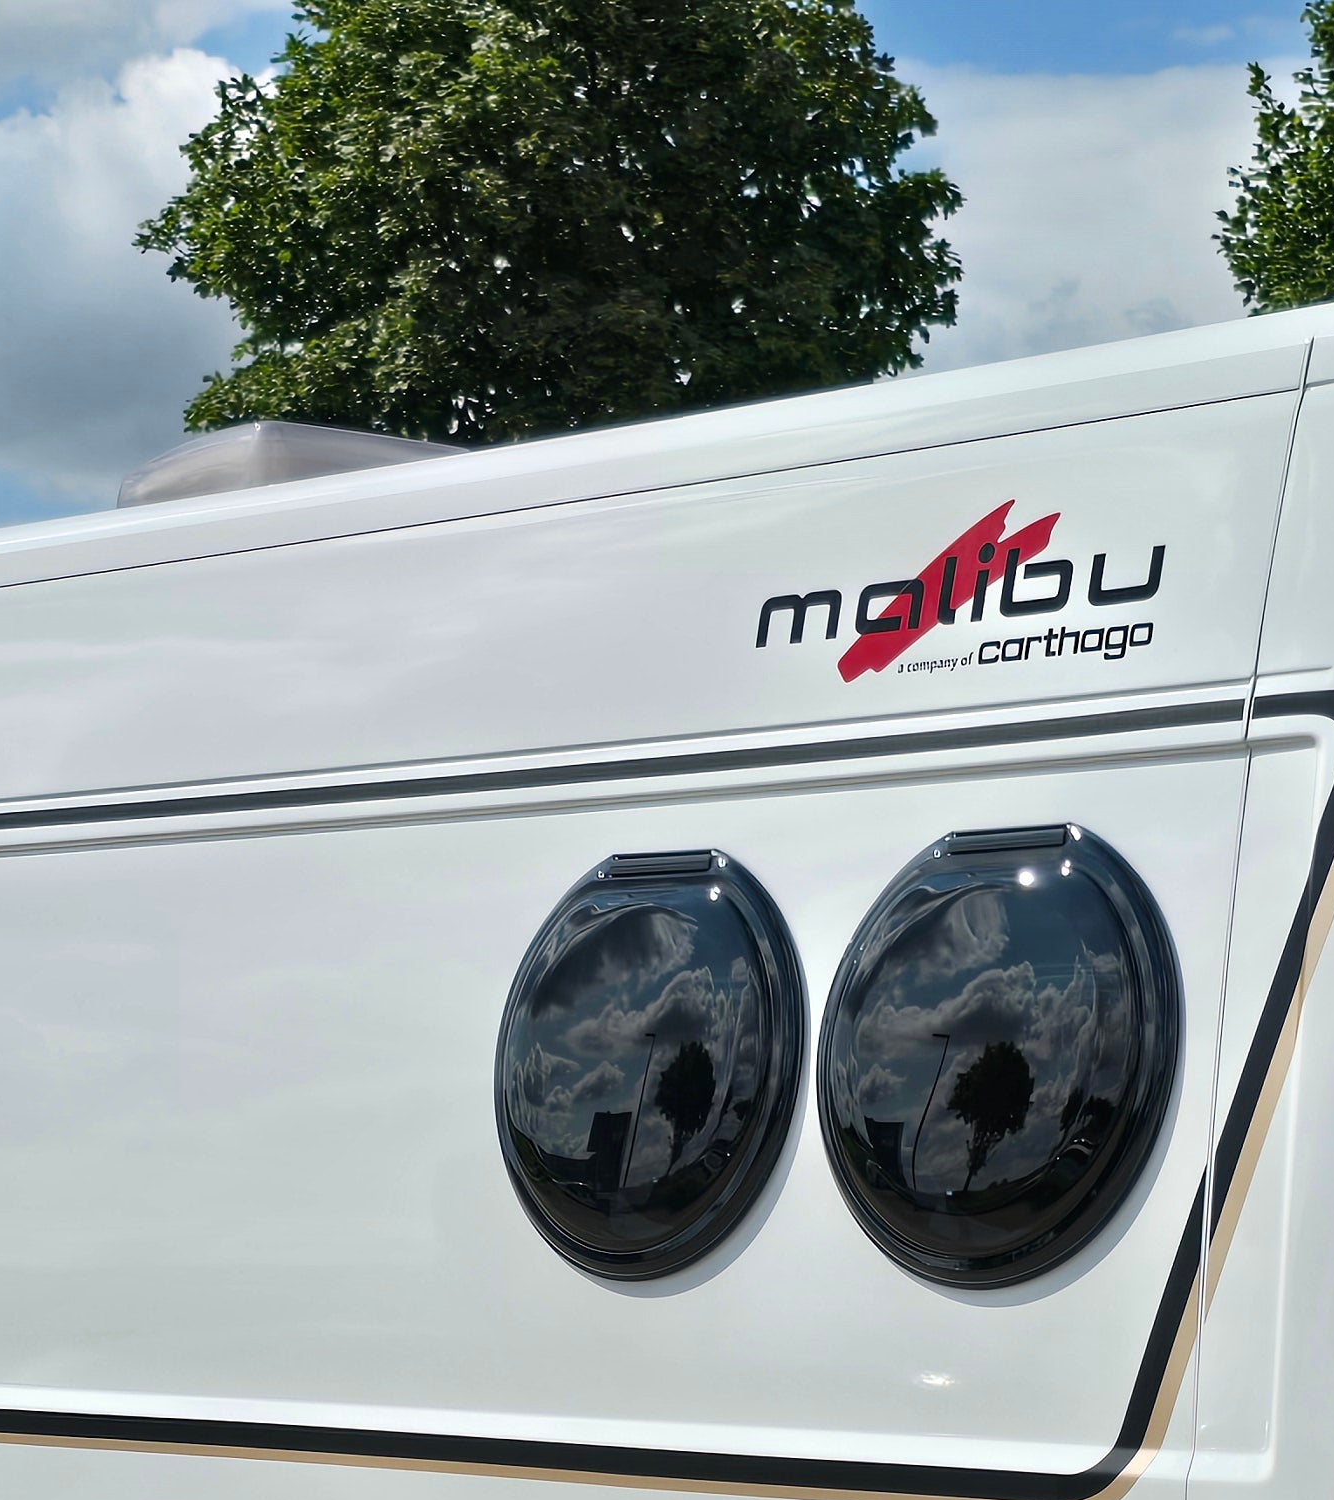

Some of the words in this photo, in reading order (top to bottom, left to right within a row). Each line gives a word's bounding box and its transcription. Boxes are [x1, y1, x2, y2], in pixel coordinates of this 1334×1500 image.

[755, 541, 1166, 648] malibu
[906, 656, 959, 674] company
[960, 653, 973, 667] of
[977, 622, 1154, 666] carthago
